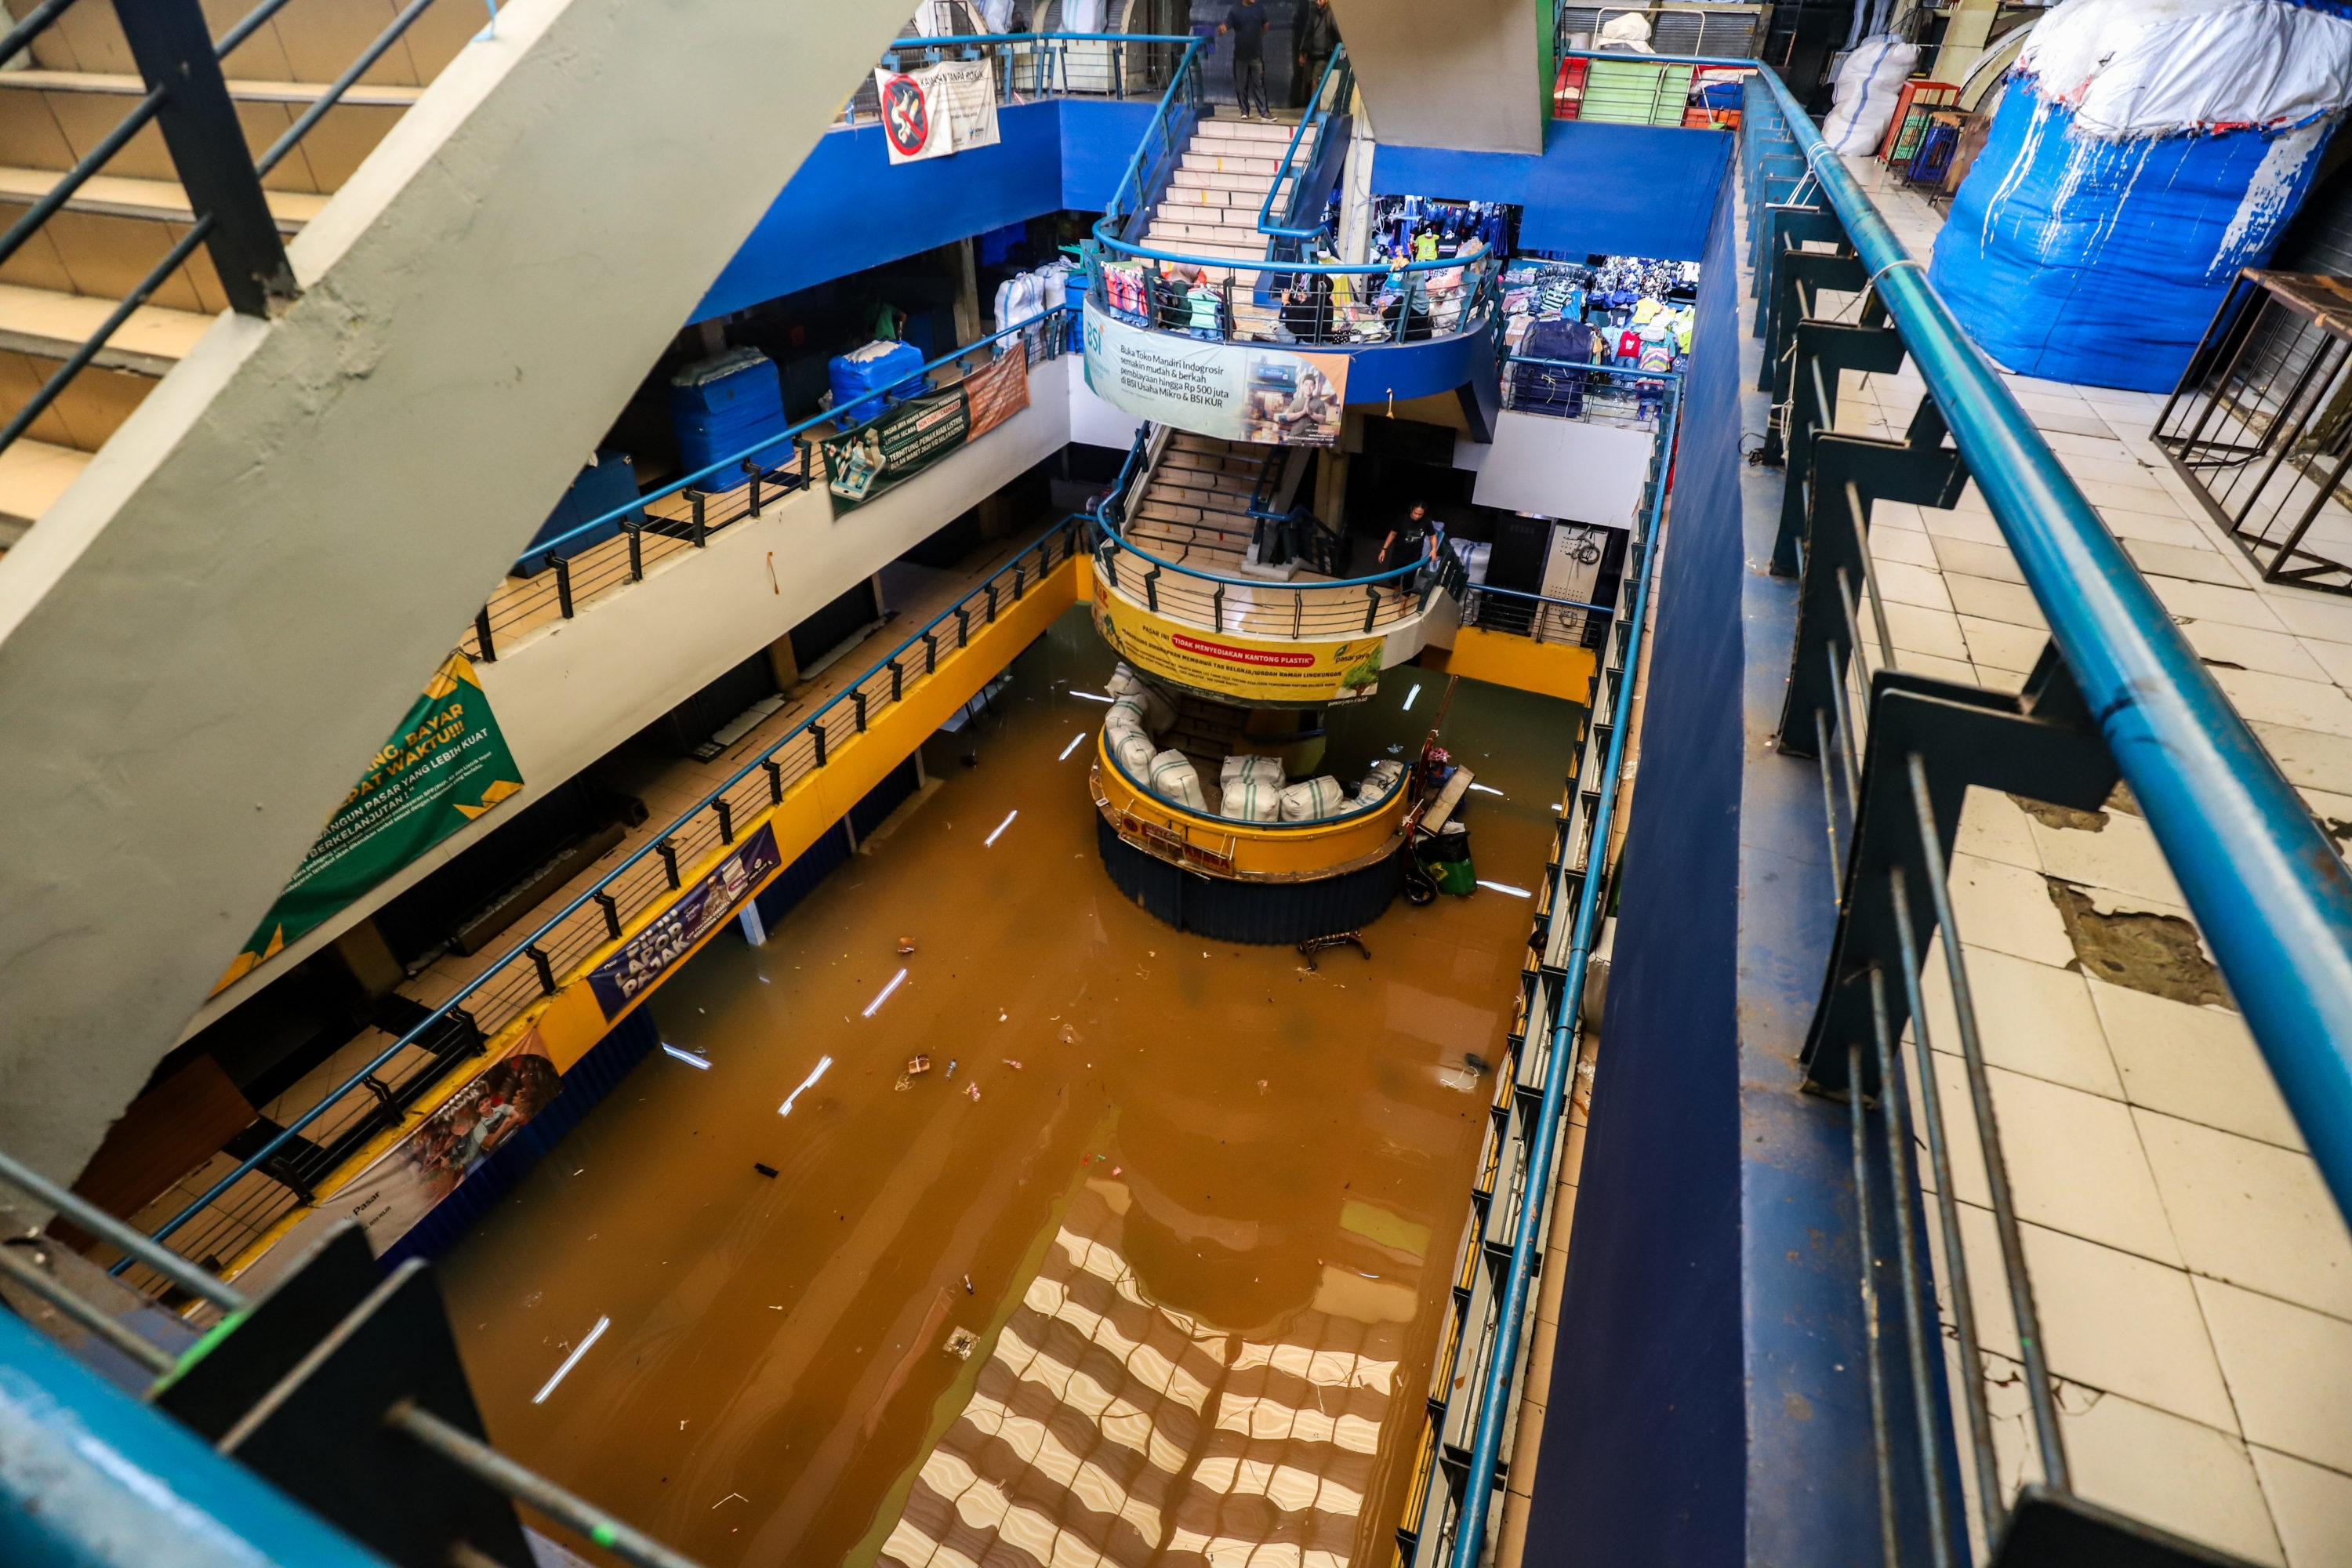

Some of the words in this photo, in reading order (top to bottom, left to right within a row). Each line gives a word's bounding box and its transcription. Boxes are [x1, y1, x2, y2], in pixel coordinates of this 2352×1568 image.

[1087, 321, 1102, 355] BSI
[1120, 357, 1145, 371] semakin
[1146, 365, 1171, 376] mudah
[1171, 369, 1178, 378] &
[1178, 371, 1207, 383] berkah
[1121, 344, 1135, 357] Buka
[1136, 350, 1152, 362] Toko
[1152, 354, 1181, 368] Mandiri
[1182, 361, 1225, 376] Indogrosir
[1120, 367, 1158, 384] pembiayaan
[1159, 377, 1184, 390] hingga
[1184, 382, 1196, 393] Rp
[1196, 384, 1213, 395] 500
[1213, 387, 1229, 398] juta
[1120, 376, 1127, 384] di
[1127, 378, 1137, 388] BSI
[1137, 382, 1159, 394] Usaha
[1159, 387, 1181, 400] Mikro
[1182, 392, 1189, 401] &
[1190, 394, 1203, 405] BSI
[1204, 396, 1223, 408] KUR
[889, 441, 920, 462] TERHITUNG
[919, 427, 947, 446] PEMAKAIAN
[946, 416, 964, 430] LISTRIK
[900, 425, 916, 438] SECARA
[1142, 625, 1160, 637] PASAR
[1194, 643, 1243, 659] MENYEDIAKAN
[1244, 653, 1279, 662] KANTONG
[1181, 655, 1212, 666] MEMBAWA
[367, 743, 404, 772] NG,
[405, 703, 464, 746] BAYAR
[386, 720, 465, 775] WAKTU!!!
[365, 784, 401, 811] PASAR
[401, 764, 430, 787] YANG
[430, 745, 462, 768] LEBIH
[461, 728, 488, 749] KUAT
[306, 851, 333, 871] pedagang
[392, 793, 423, 816] pembayaran
[310, 795, 405, 858] BERKELANJUTAN
[312, 857, 336, 875] tersebut
[335, 848, 350, 860] akan
[349, 830, 377, 851] dikenakan
[376, 818, 394, 833] sanksi
[393, 809, 411, 822] sesuai
[411, 798, 430, 811] dengan
[615, 922, 683, 988] LAPOR
[622, 931, 691, 999] PAJAK
[353, 1191, 379, 1216] Pasar
